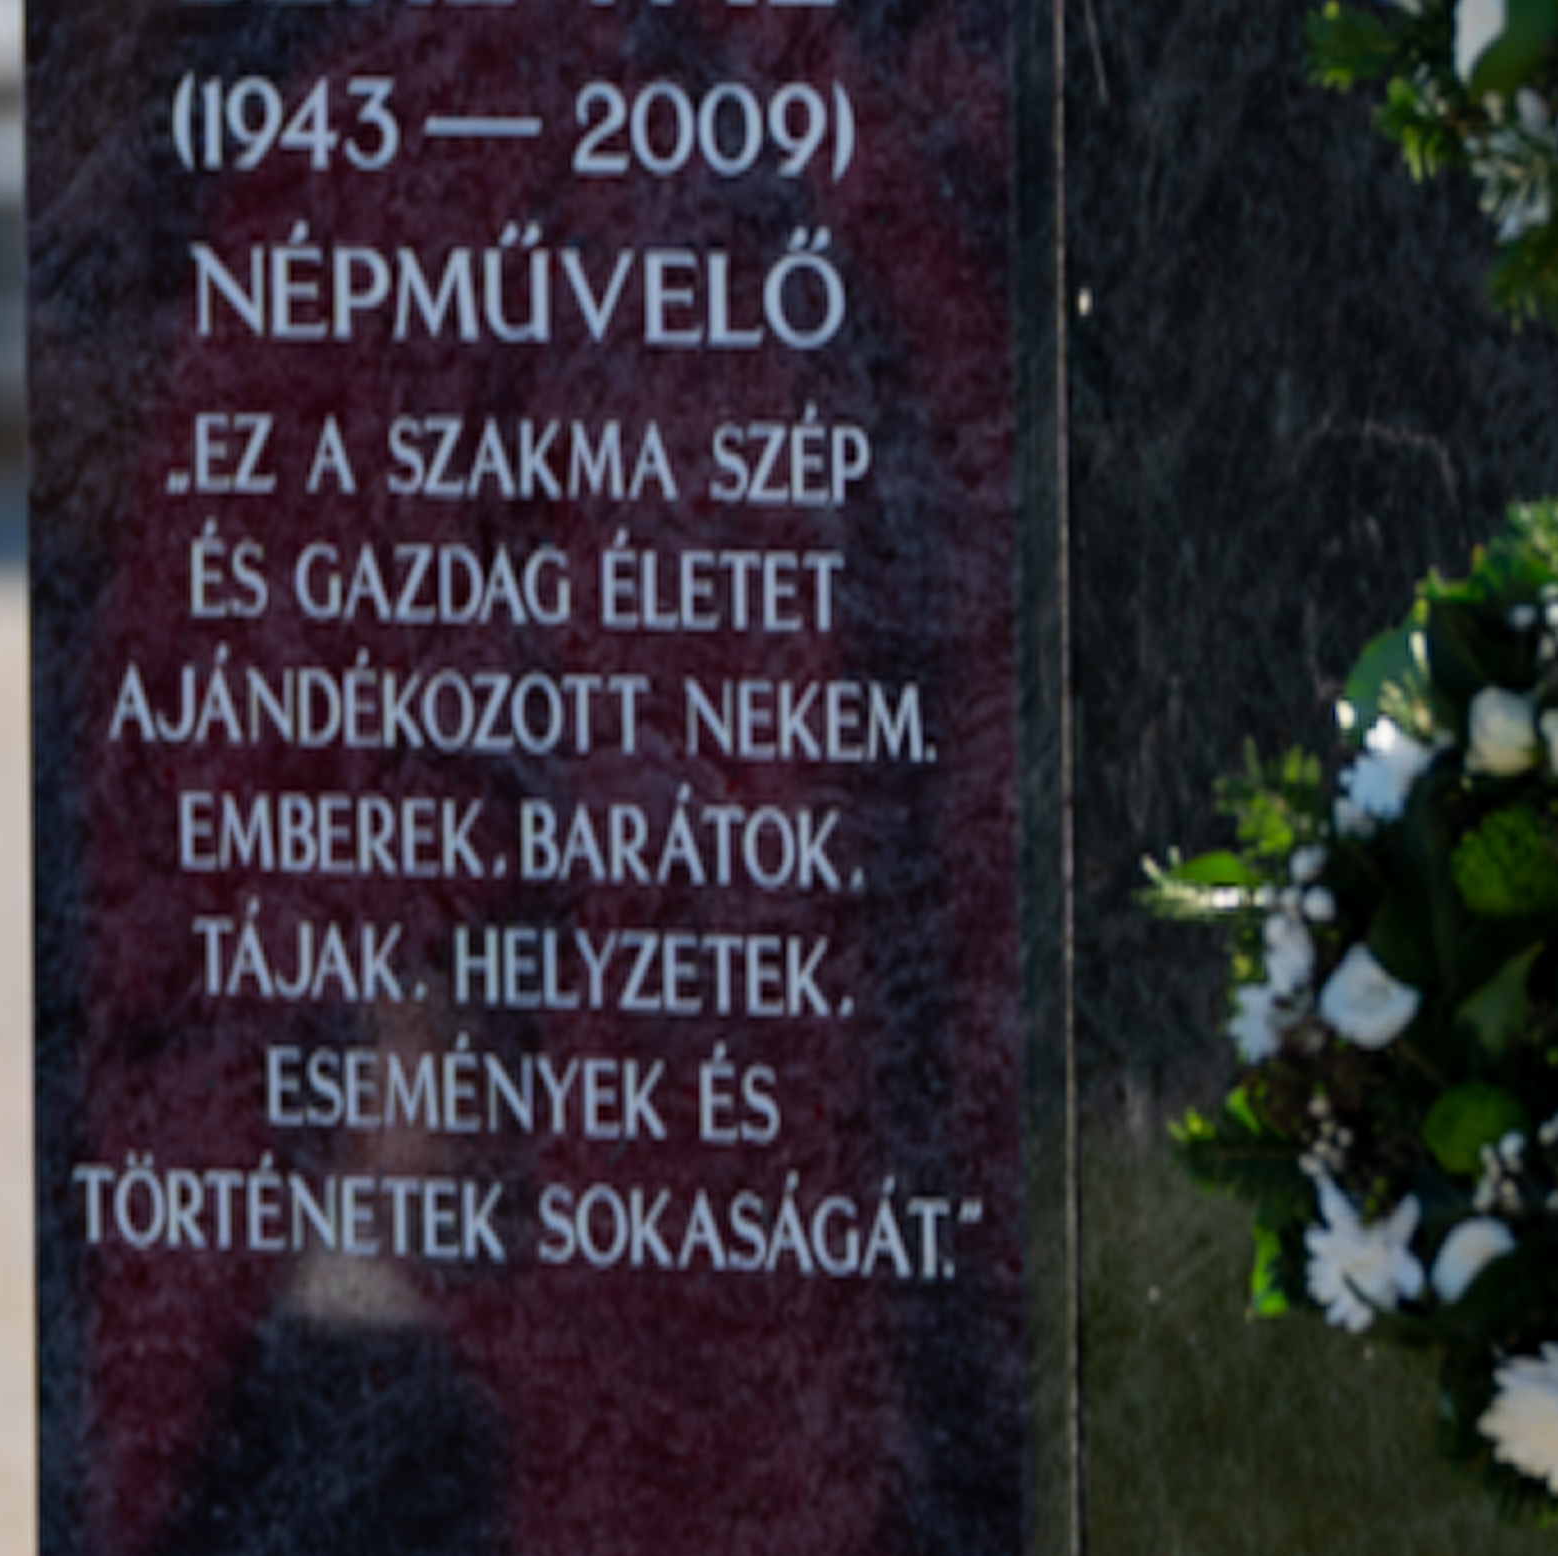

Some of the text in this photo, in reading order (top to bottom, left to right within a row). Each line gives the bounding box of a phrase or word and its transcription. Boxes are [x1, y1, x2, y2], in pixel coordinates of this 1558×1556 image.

[171, 72, 400, 171] (1943
[572, 80, 856, 181] 2009)
[191, 219, 846, 350] NÉPMŰVELŐ
[305, 415, 357, 495] A
[386, 415, 680, 502] SZAKMA
[709, 402, 871, 507] SZÉP
[189, 516, 845, 633] ÉS GAZDAG ÉLETET
[107, 642, 937, 763] AJÁNDÉKOZOTT NEKEM.
[266, 1031, 782, 1144] ESEMÉNYEK ÉS
[73, 1151, 505, 1266] TÖRTÉNETEK
